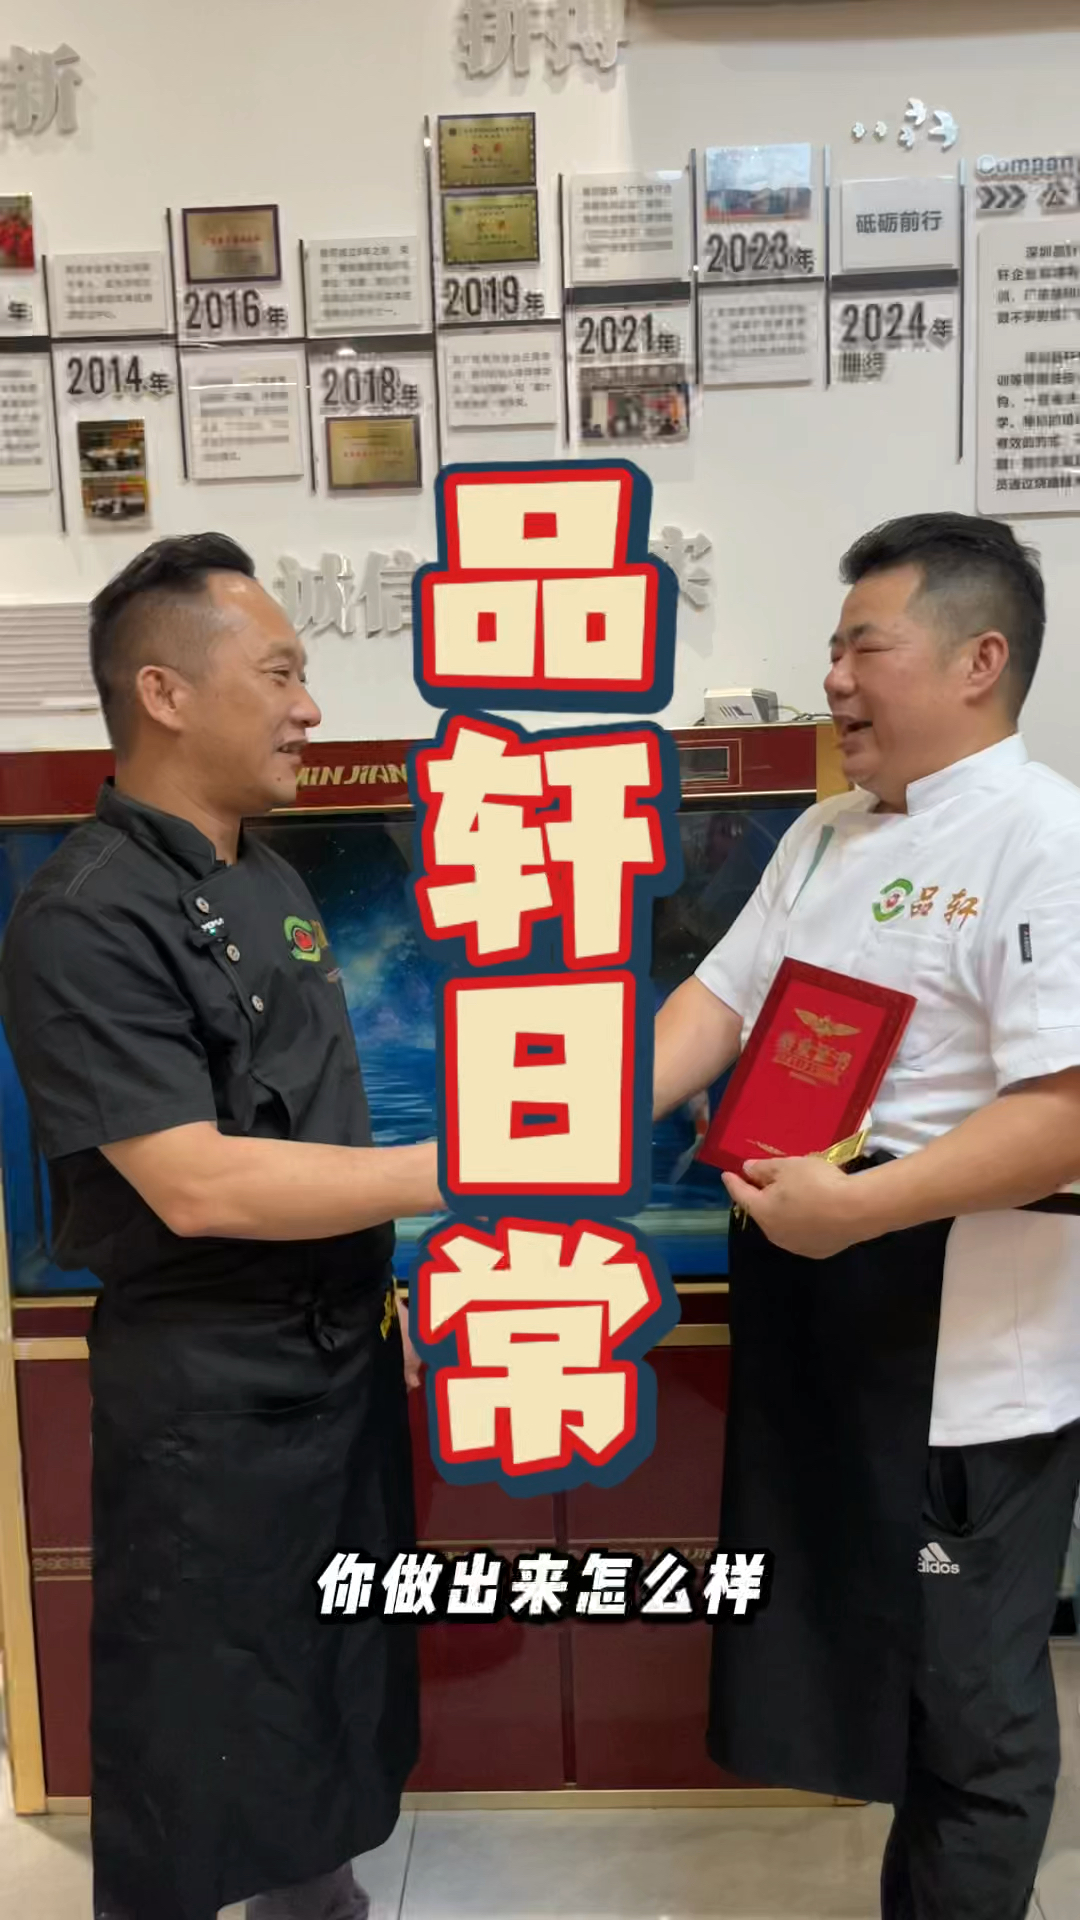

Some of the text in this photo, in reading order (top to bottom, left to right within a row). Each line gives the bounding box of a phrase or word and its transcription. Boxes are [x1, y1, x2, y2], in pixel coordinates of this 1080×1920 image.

[978, 155, 1080, 176] Compan
[1040, 185, 1080, 210] 公
[856, 210, 943, 234] 砥砺前行
[706, 232, 815, 274] 2023年
[185, 288, 287, 330] 2016年
[443, 275, 545, 317] 2019年
[578, 315, 680, 354] 2021年
[841, 300, 953, 342] 2024年
[66, 355, 170, 395] 2014年
[322, 367, 420, 405] 2018年
[910, 886, 980, 931] 品轩
